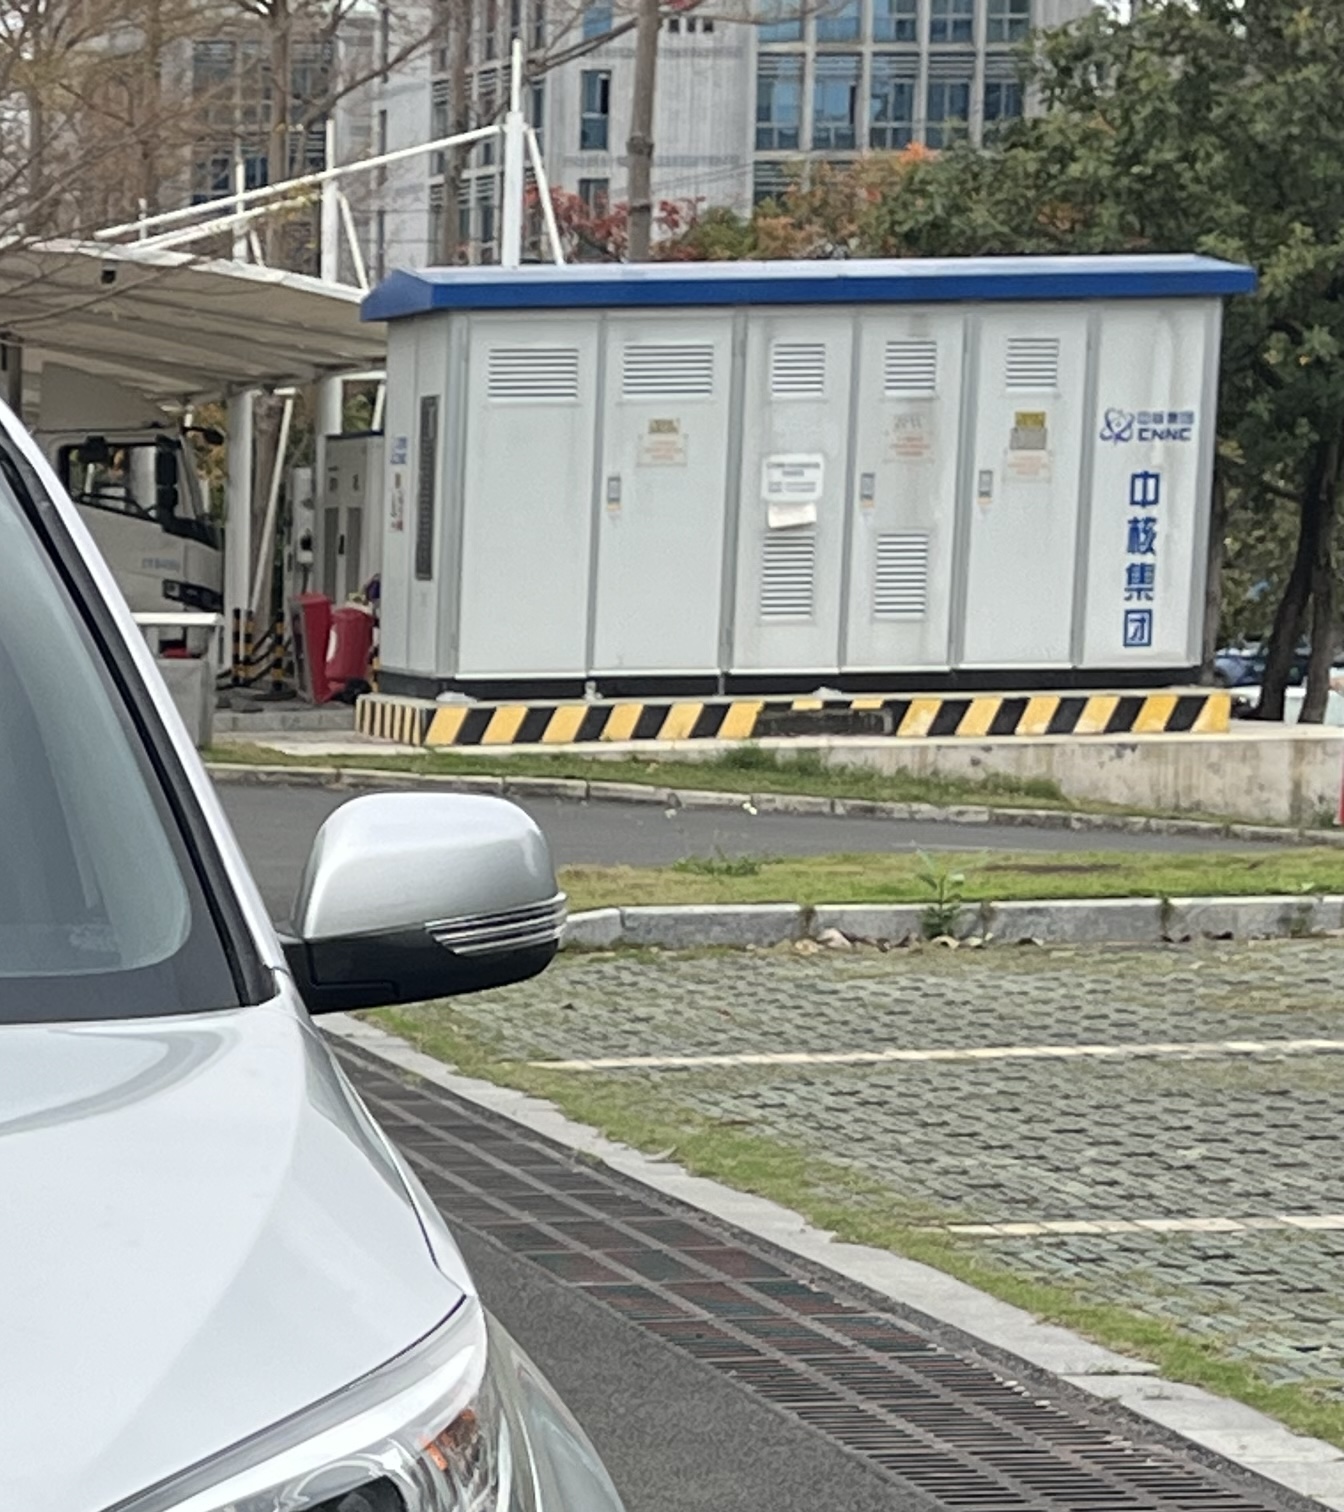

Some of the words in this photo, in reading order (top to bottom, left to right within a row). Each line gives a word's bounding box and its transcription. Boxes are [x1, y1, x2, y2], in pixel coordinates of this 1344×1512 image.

[1138, 428, 1192, 441] CNNC
[1123, 471, 1160, 648] 中核集团
